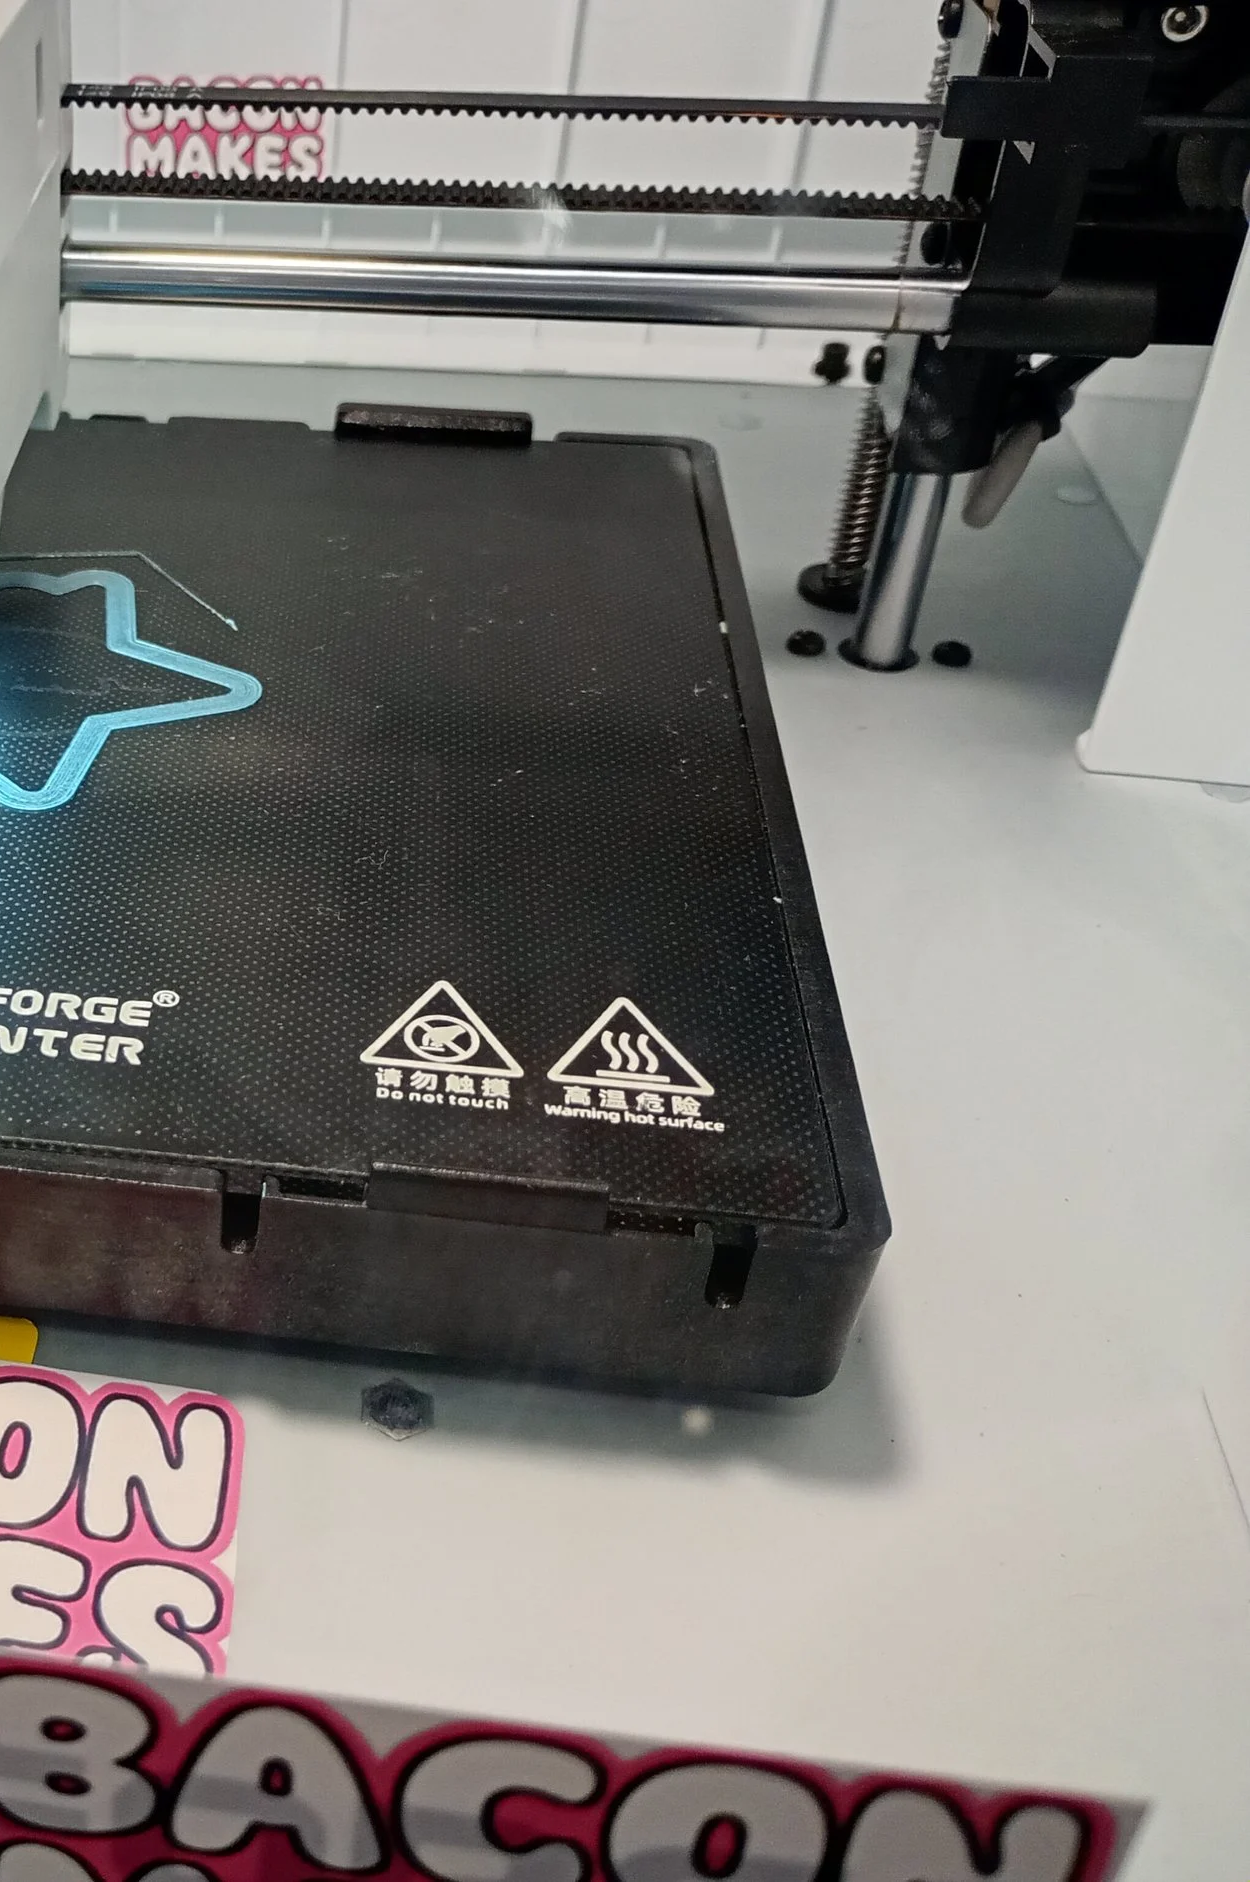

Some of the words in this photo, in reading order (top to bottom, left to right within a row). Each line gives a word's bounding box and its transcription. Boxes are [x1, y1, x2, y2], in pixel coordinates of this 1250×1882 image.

[127, 132, 324, 182] MAKES
[375, 1067, 511, 1099] 请勿触摸
[375, 1087, 404, 1099] Do
[409, 1092, 444, 1105] not
[449, 1094, 510, 1111] touch
[563, 1086, 702, 1117] 高温危险
[544, 1103, 621, 1124] Warning
[624, 1110, 655, 1126] hot
[658, 1116, 726, 1132] surface
